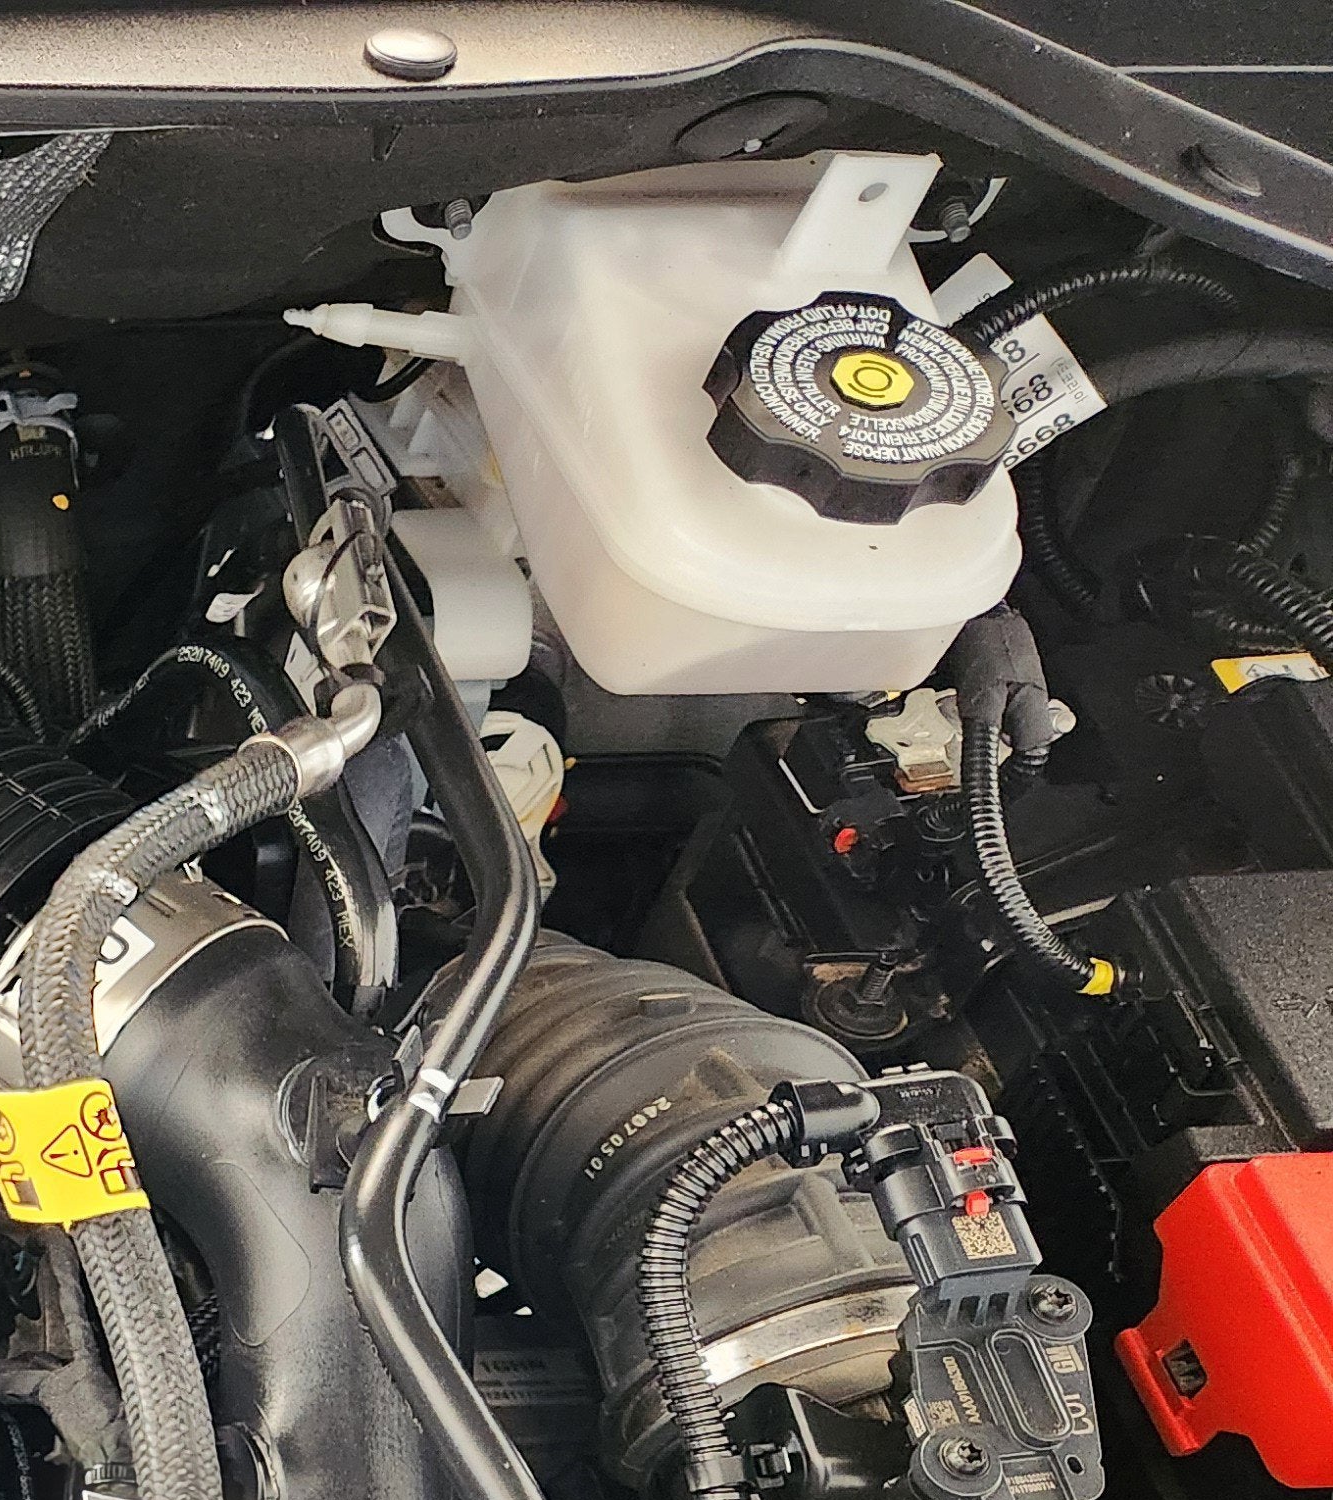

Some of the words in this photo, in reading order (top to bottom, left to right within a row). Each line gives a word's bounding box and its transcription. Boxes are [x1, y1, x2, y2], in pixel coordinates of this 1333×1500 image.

[793, 317, 857, 342] BEFORE
[852, 317, 891, 336] CAP
[786, 399, 834, 431] ONLY
[794, 382, 843, 419] FILLER
[230, 676, 253, 708] 423
[247, 705, 269, 735] ME
[1045, 1344, 1079, 1375] GM
